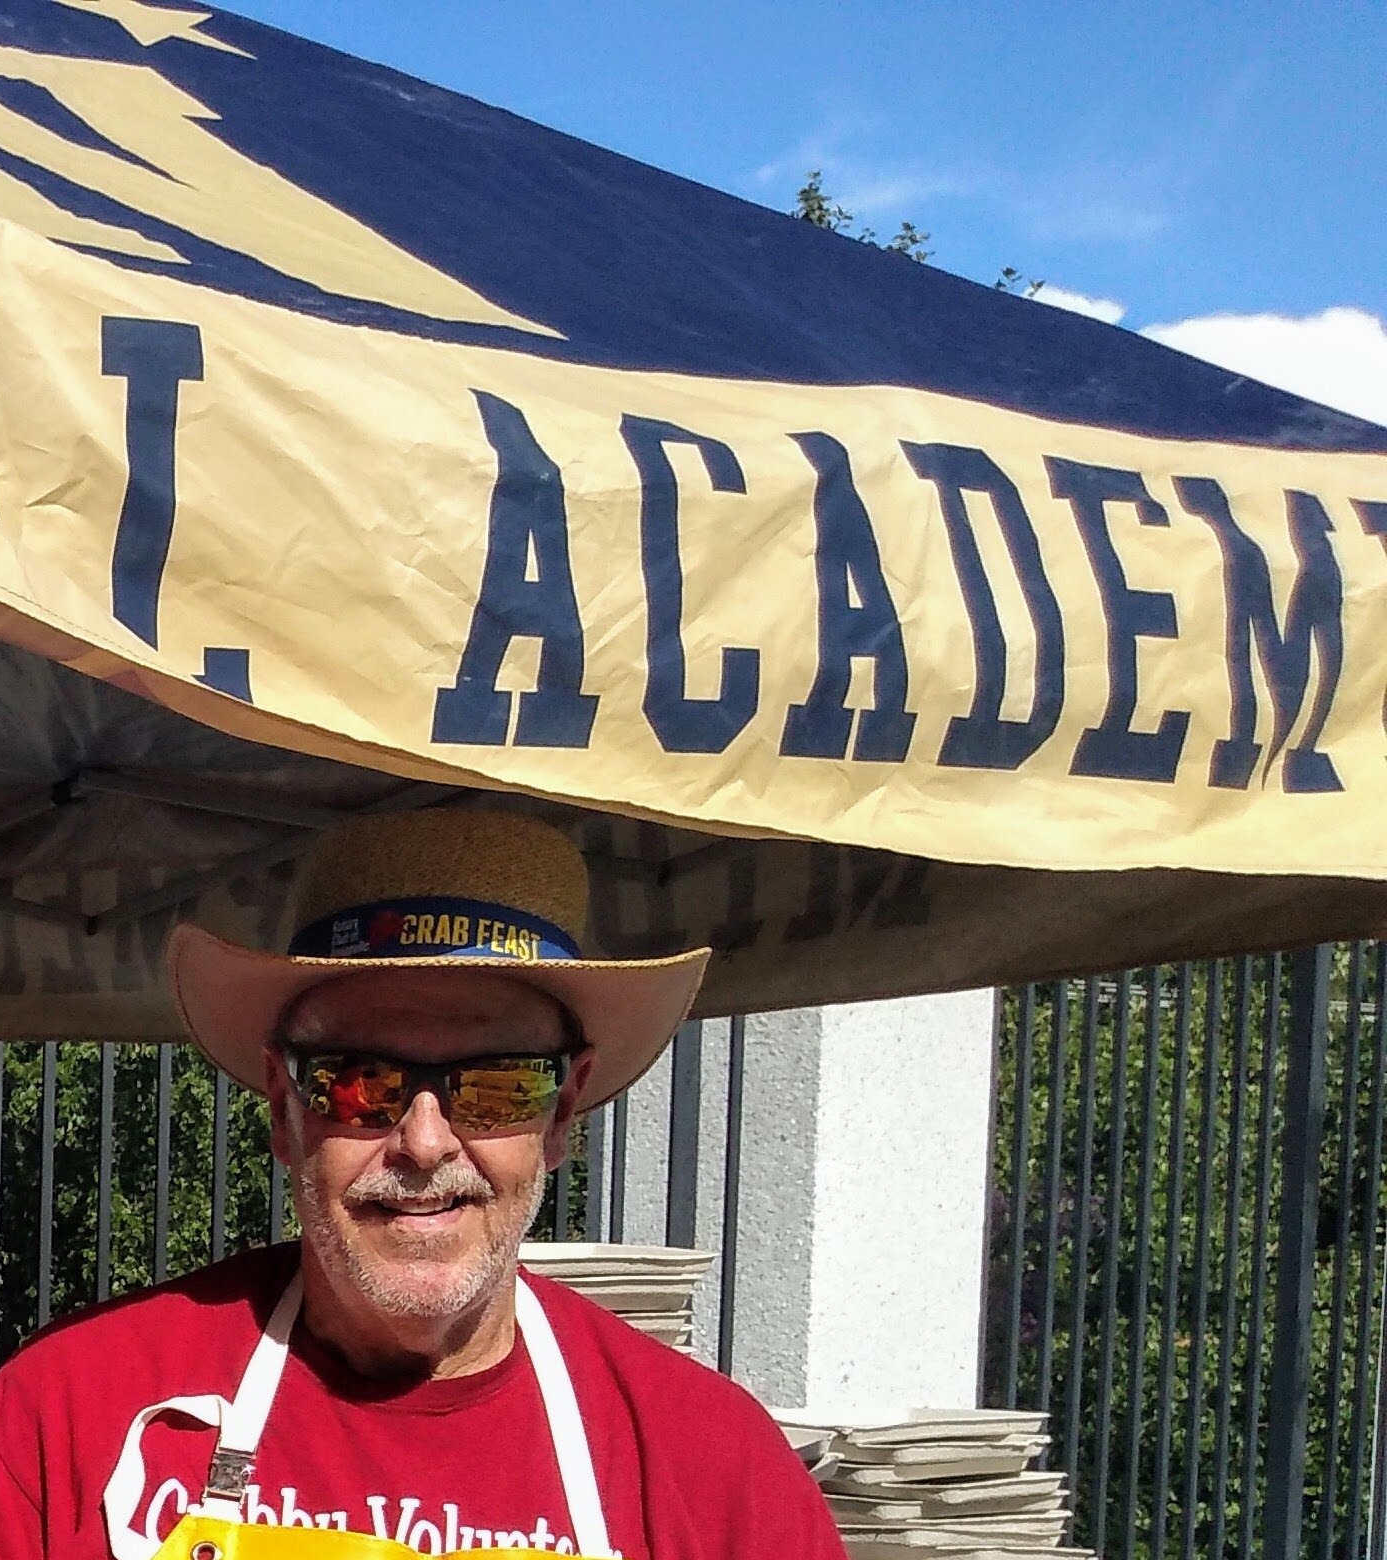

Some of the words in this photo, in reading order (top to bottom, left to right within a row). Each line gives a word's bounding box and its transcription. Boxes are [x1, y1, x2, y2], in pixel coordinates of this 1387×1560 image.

[430, 386, 1387, 794] ACADEM
[400, 914, 470, 946] CRAB
[476, 918, 542, 961] FEAST
